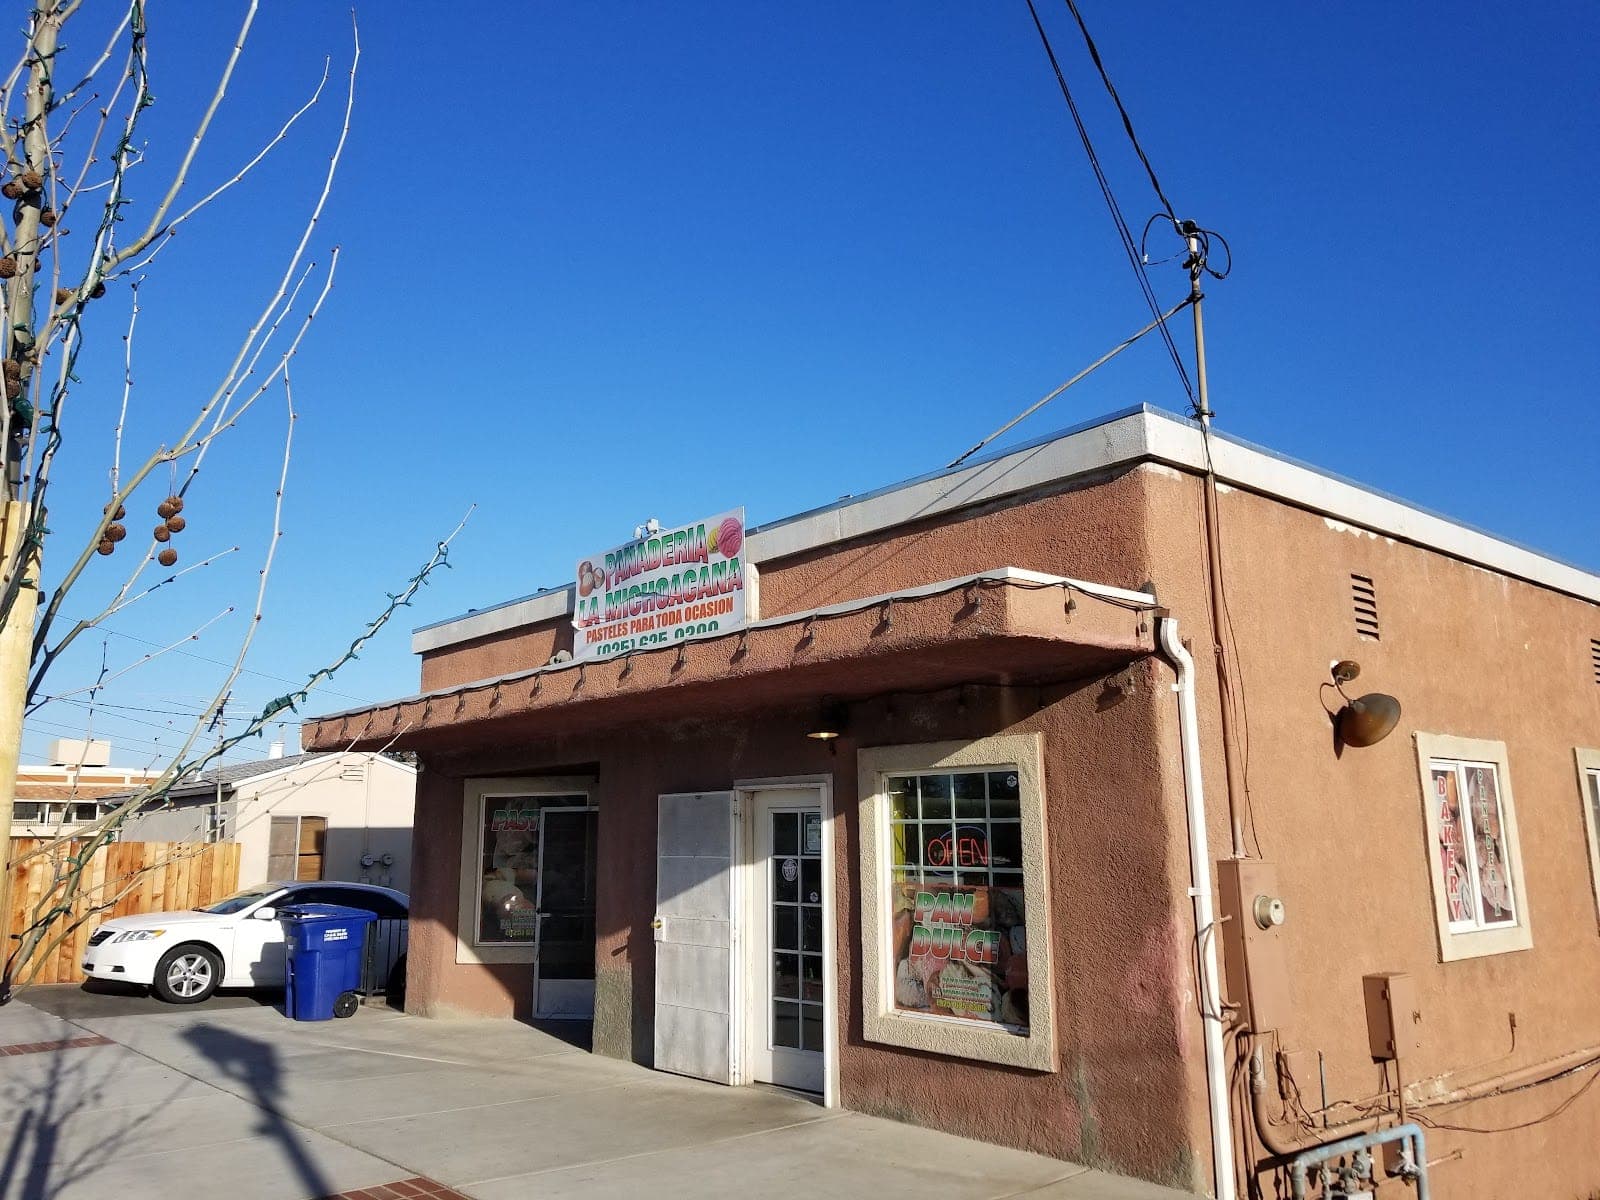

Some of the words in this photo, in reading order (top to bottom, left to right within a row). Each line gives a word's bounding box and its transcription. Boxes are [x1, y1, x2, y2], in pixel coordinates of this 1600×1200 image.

[604, 524, 708, 592] PANADERIA
[578, 596, 600, 628] LA
[605, 558, 743, 623] MICHOACANA
[586, 622, 628, 644] PASTELES
[630, 615, 655, 634] PARA
[656, 608, 682, 628] TODA
[685, 597, 733, 620] OCASION
[928, 838, 989, 866] OPEN
[1437, 776, 1461, 921] BAKERY
[914, 892, 974, 925] PAN
[911, 925, 1000, 964] DULCE
